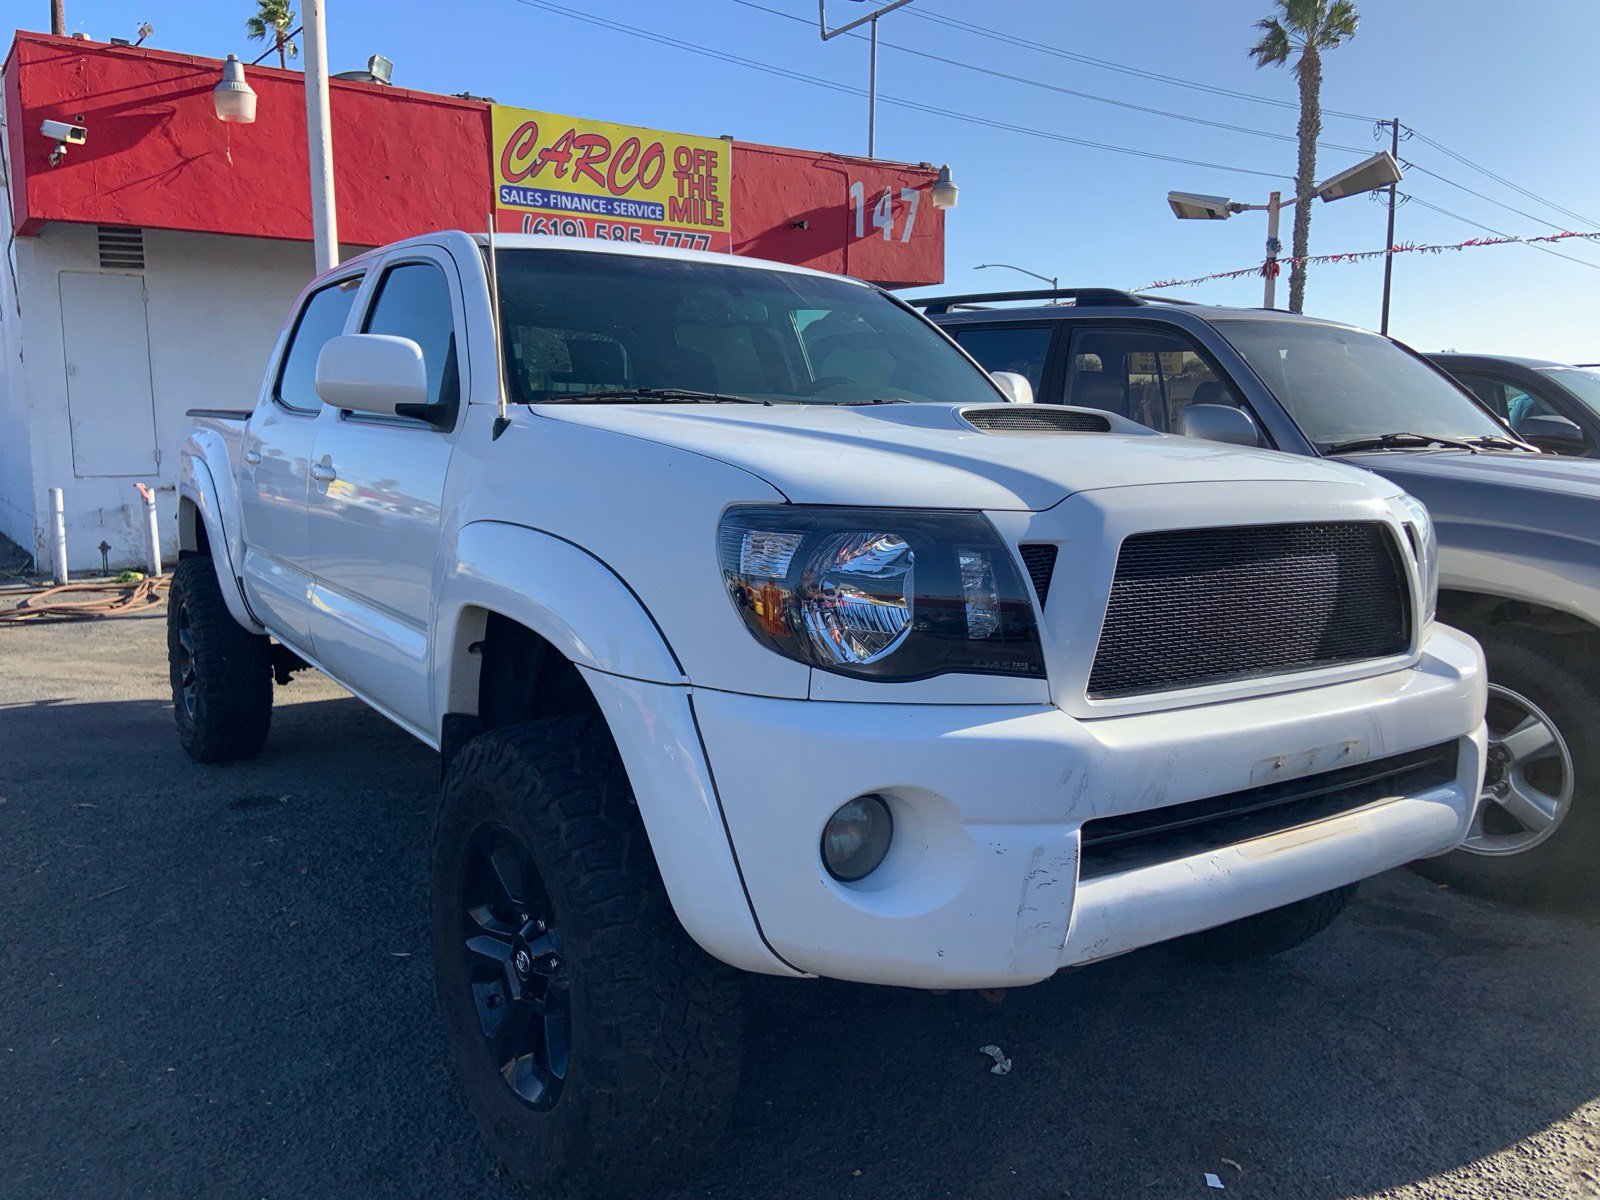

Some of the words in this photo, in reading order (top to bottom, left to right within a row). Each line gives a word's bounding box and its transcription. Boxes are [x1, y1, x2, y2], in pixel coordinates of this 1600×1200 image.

[500, 120, 666, 196] CARCO
[673, 145, 718, 177] OFF
[673, 171, 719, 202] THE
[501, 188, 543, 206] SALES
[549, 194, 607, 214] FINANCE
[613, 200, 663, 220] SERVICE
[668, 195, 725, 228] MILE
[850, 181, 920, 243] 147
